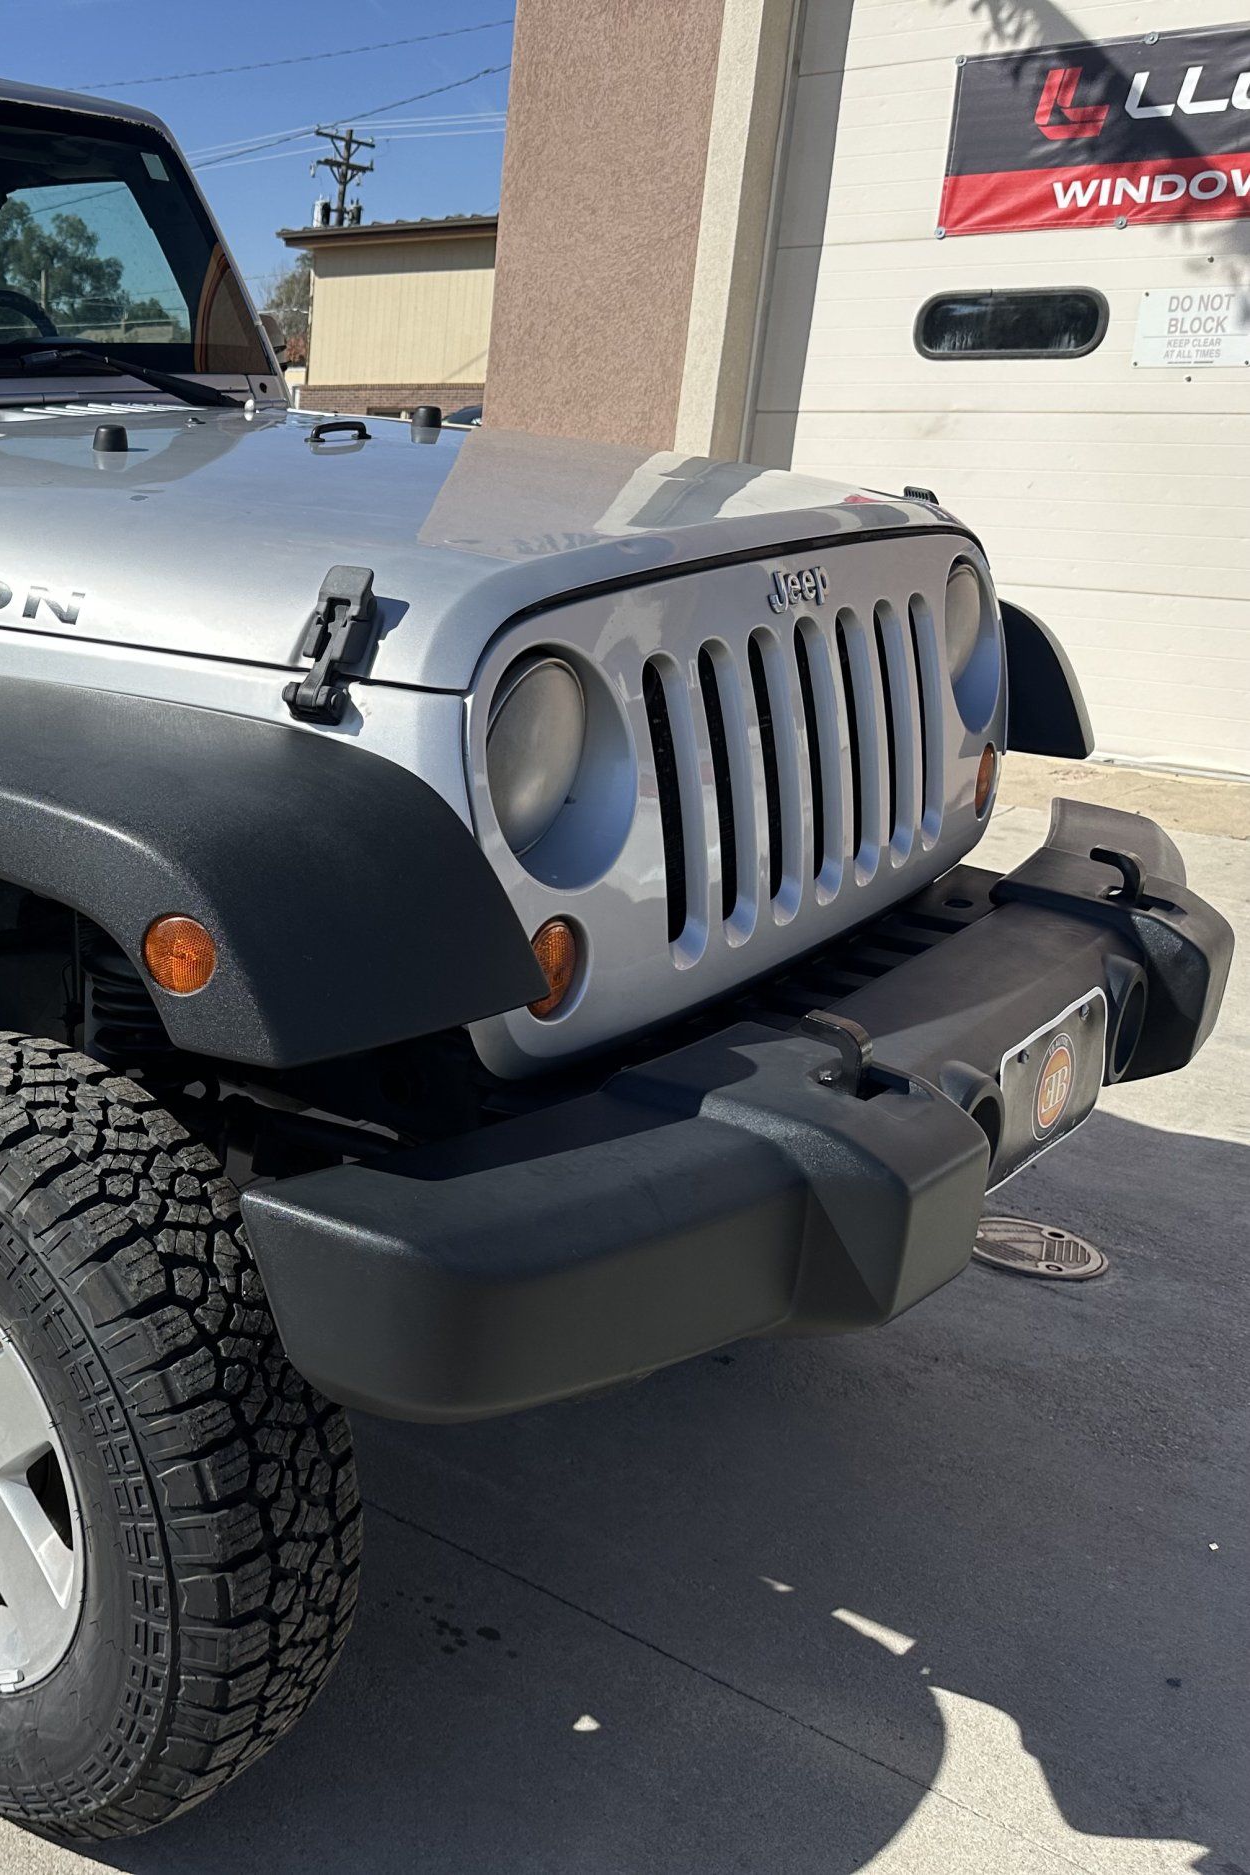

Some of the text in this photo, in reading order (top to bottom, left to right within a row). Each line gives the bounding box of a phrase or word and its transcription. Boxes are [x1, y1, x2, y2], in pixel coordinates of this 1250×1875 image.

[1168, 294, 1235, 312] DO NOT
[1167, 316, 1228, 334] BLOCK
[1166, 338, 1222, 348] KEEP CLEAR
[1163, 349, 1221, 359] AT ALL TIMES
[768, 566, 829, 614] Jeep
